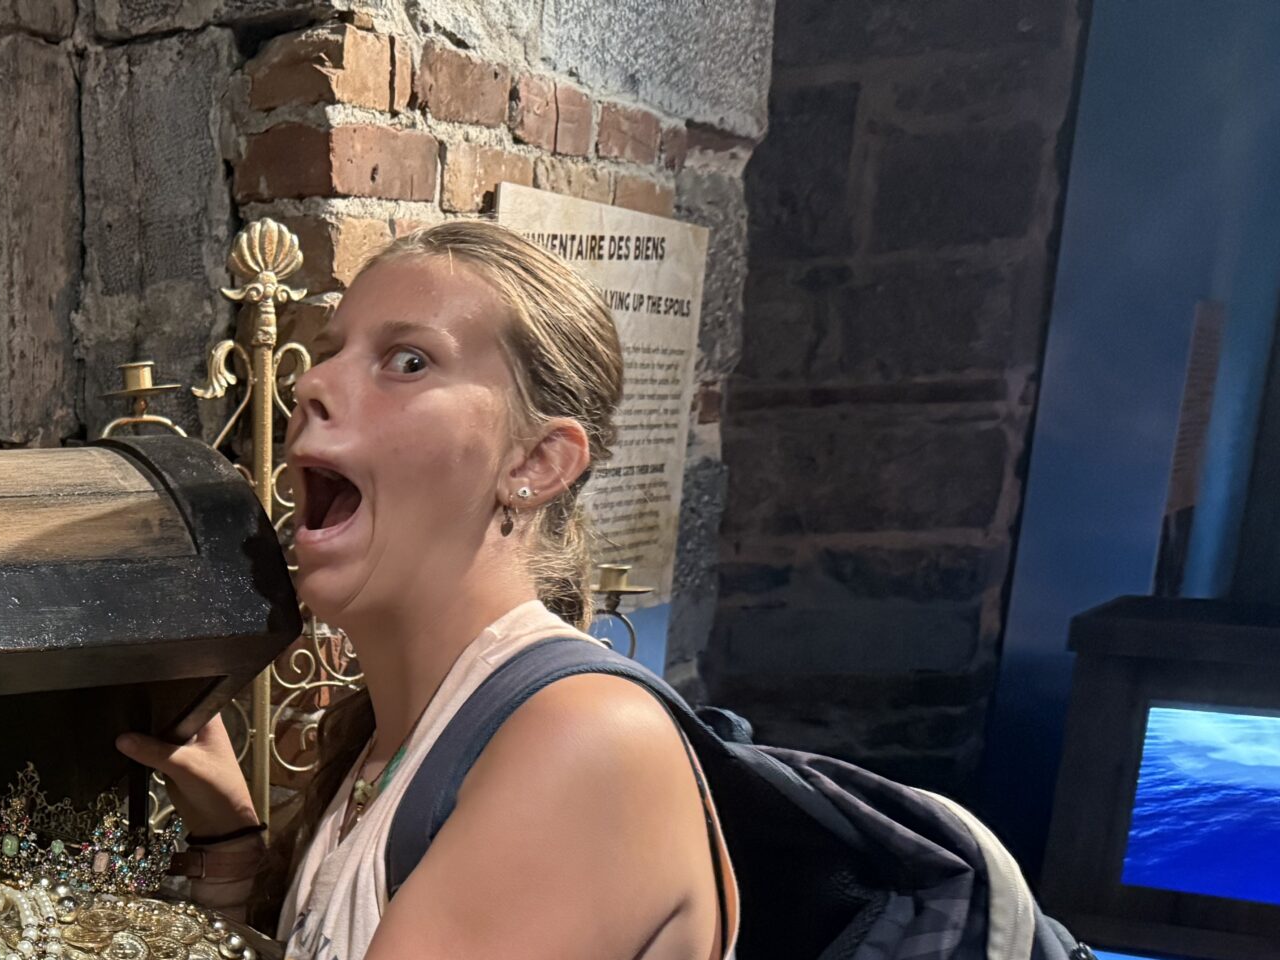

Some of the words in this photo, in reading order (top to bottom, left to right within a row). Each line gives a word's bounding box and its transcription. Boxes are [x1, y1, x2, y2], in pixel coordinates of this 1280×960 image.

[608, 234, 631, 261] DES
[634, 235, 666, 262] BIENS
[632, 293, 644, 312] UP
[646, 295, 662, 315] THE
[664, 297, 691, 318] SPOILS
